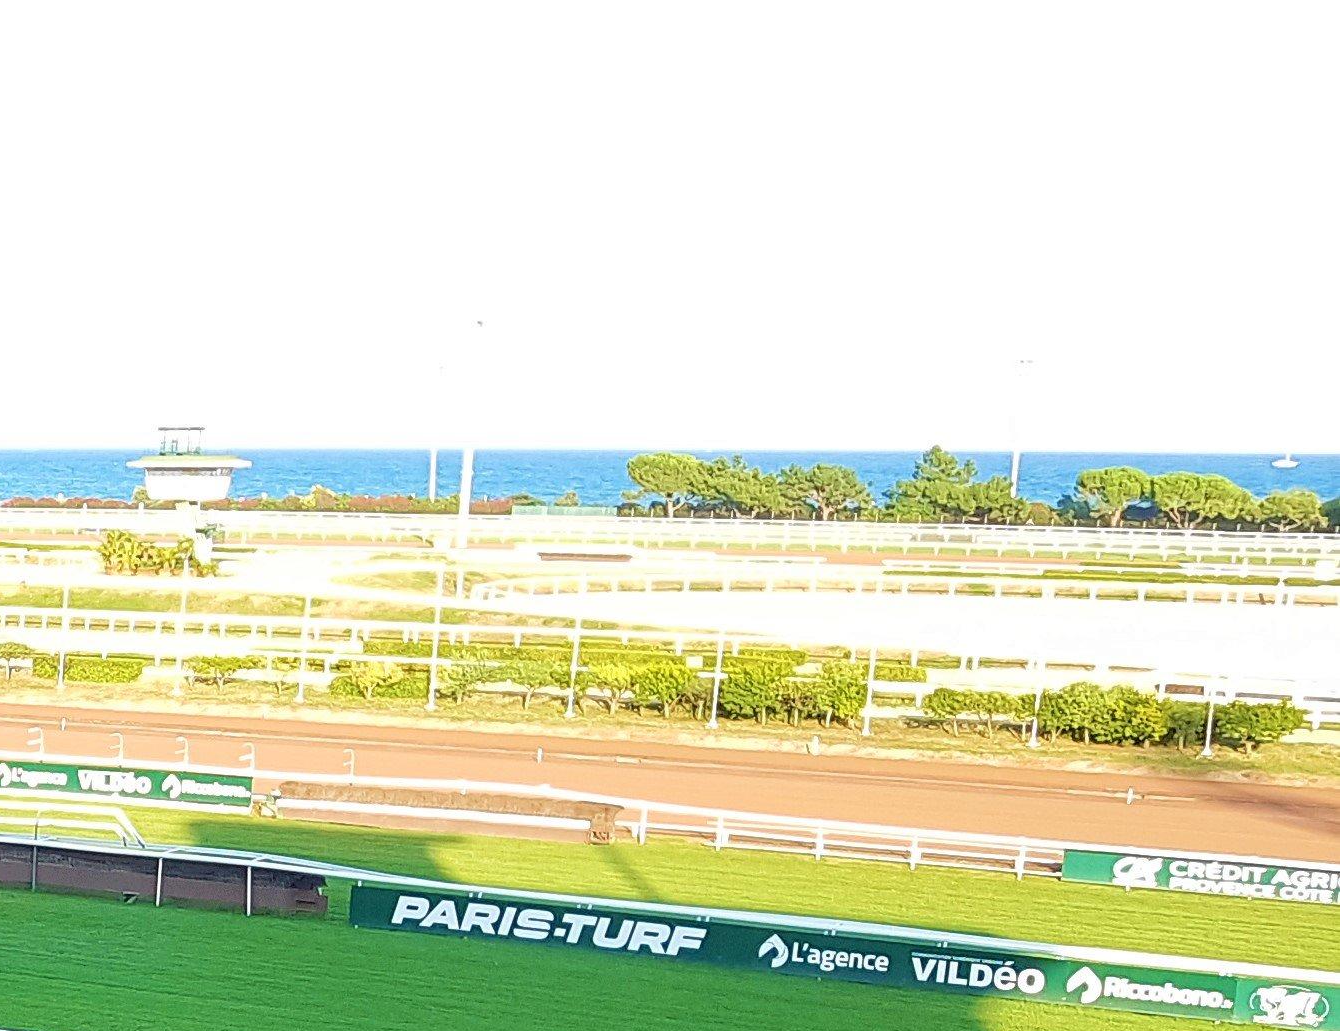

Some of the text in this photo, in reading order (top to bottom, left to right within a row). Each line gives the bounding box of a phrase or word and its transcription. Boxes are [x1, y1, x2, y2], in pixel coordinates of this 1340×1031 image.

[1168, 859, 1340, 890] CRÉDIT AGRI
[1168, 876, 1334, 904] PROVENCE CÔTE
[391, 895, 708, 957] PARIS-TURF
[791, 941, 890, 972] L'agence
